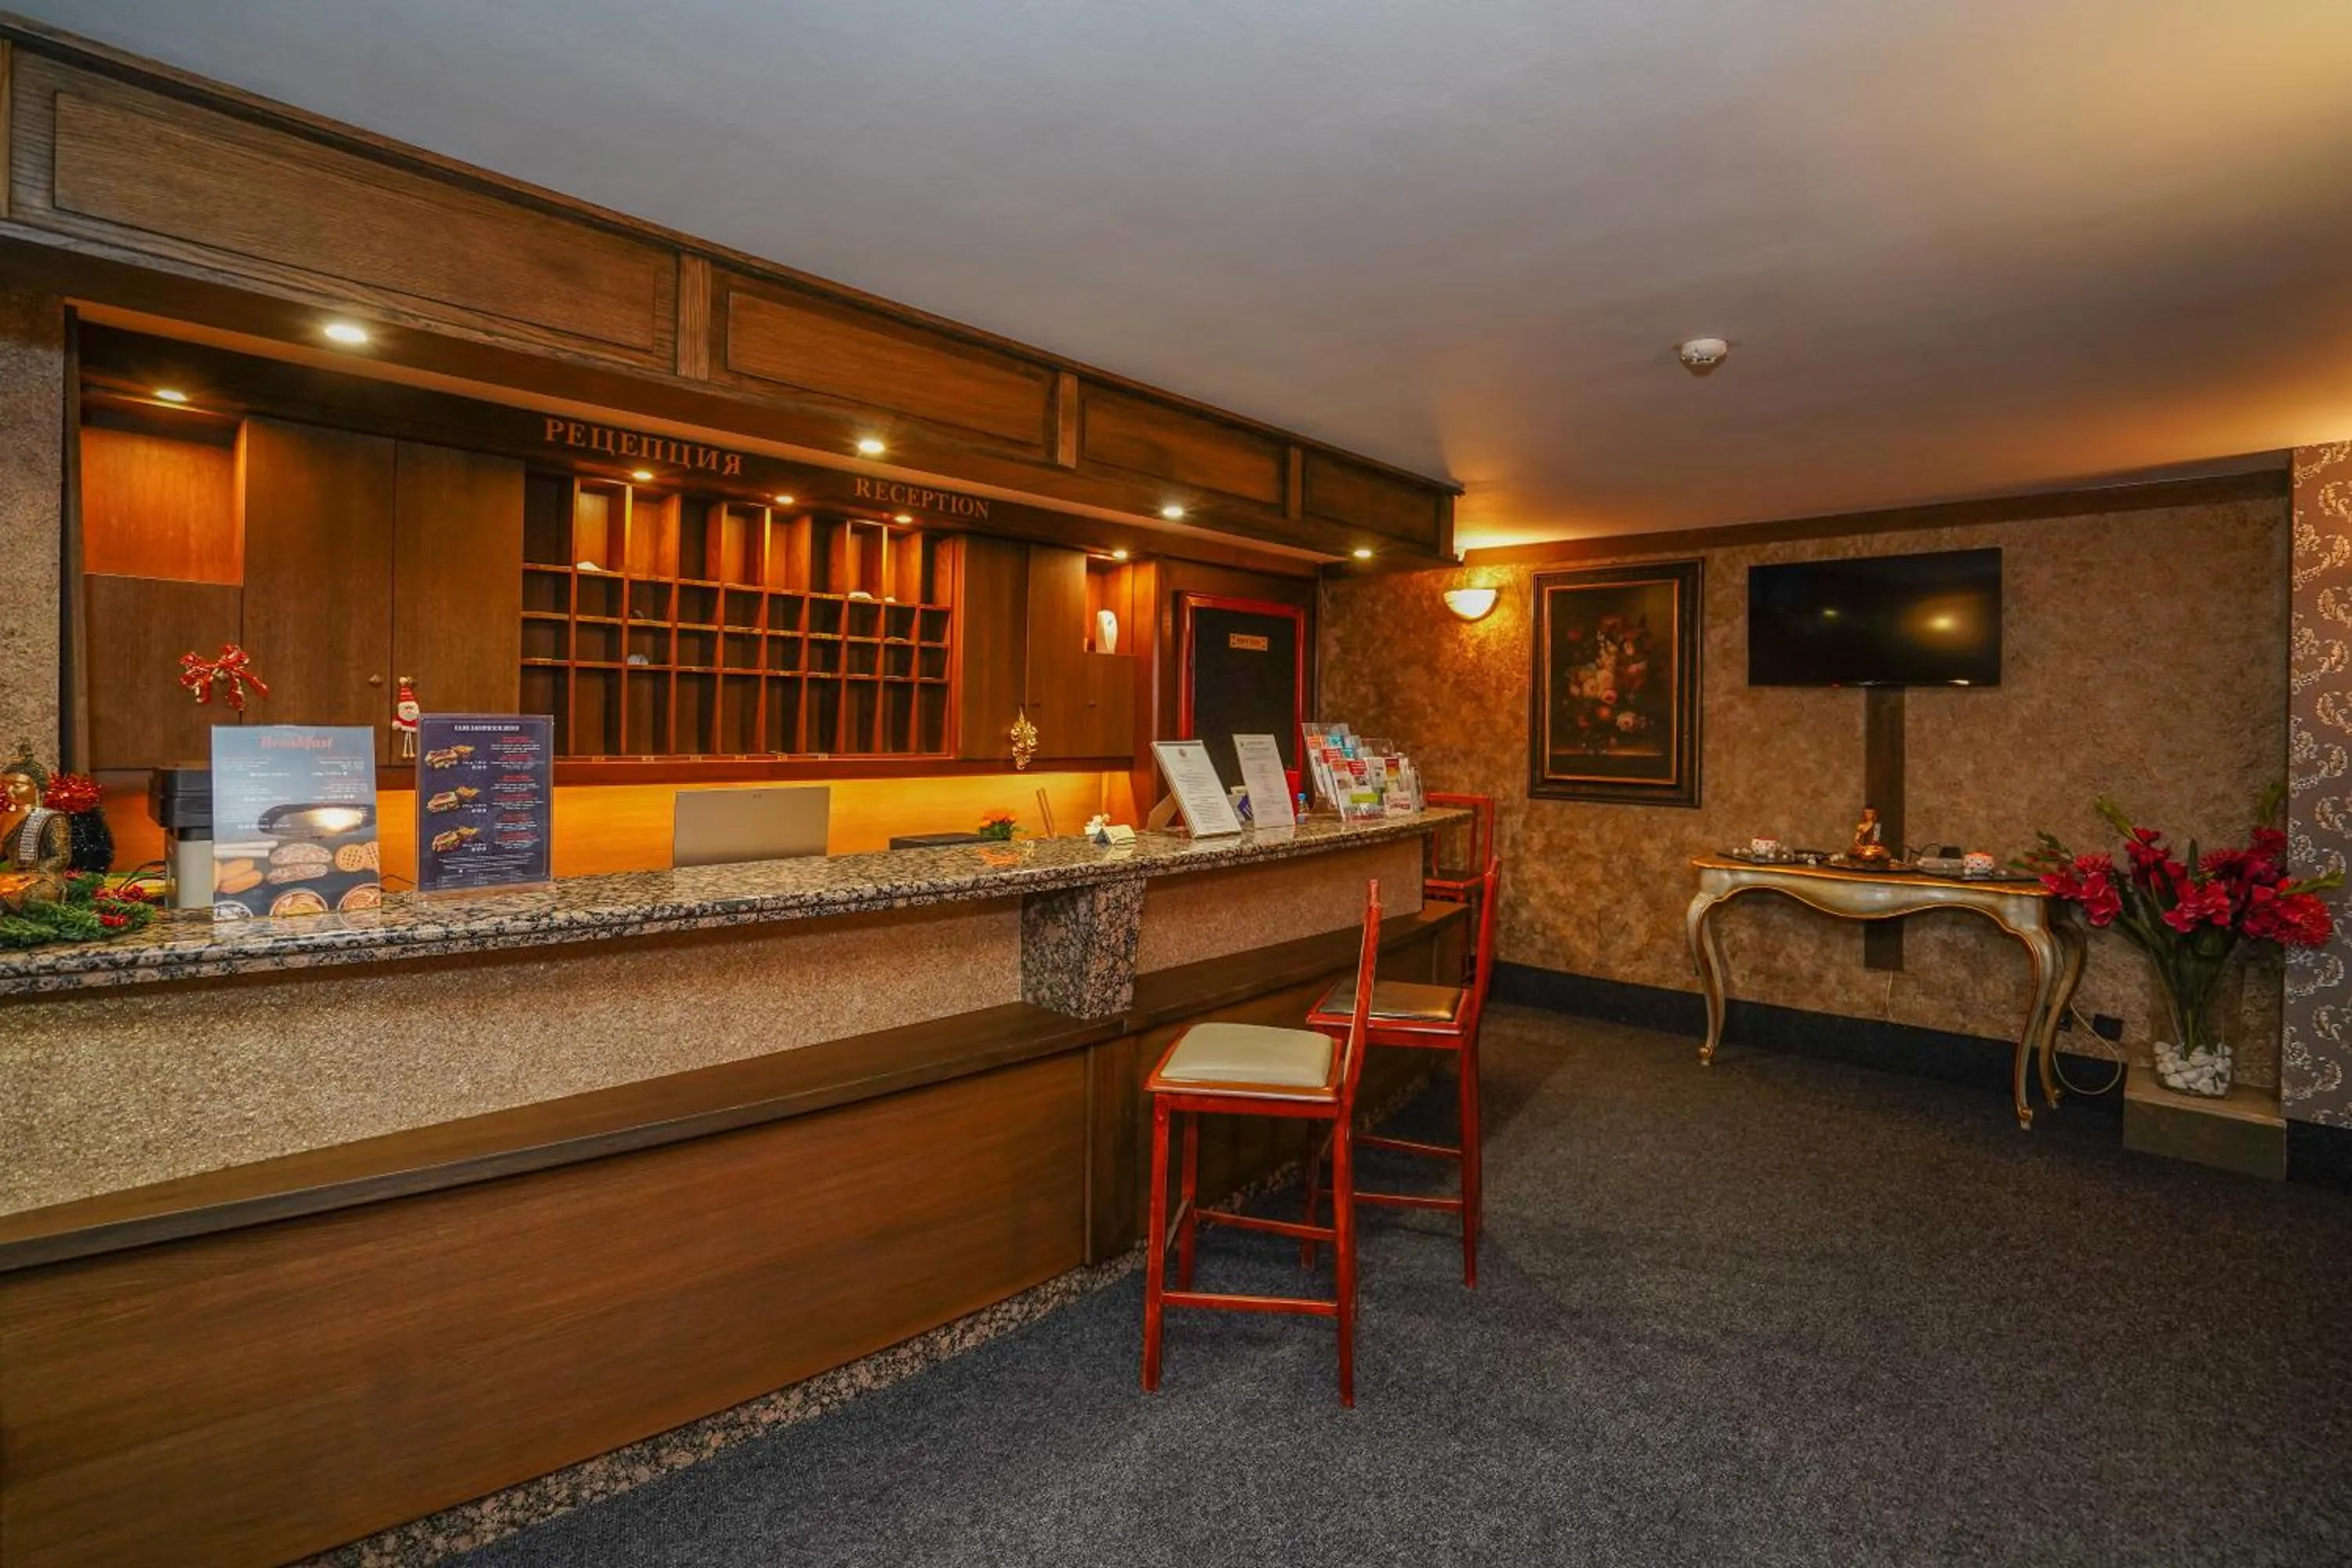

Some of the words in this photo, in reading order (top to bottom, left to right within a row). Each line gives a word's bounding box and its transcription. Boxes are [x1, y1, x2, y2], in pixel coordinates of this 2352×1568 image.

[544, 418, 743, 477] РЕЦЕПЦИЯ
[854, 477, 990, 521] RECEPTION
[260, 735, 334, 750] Breakfast
